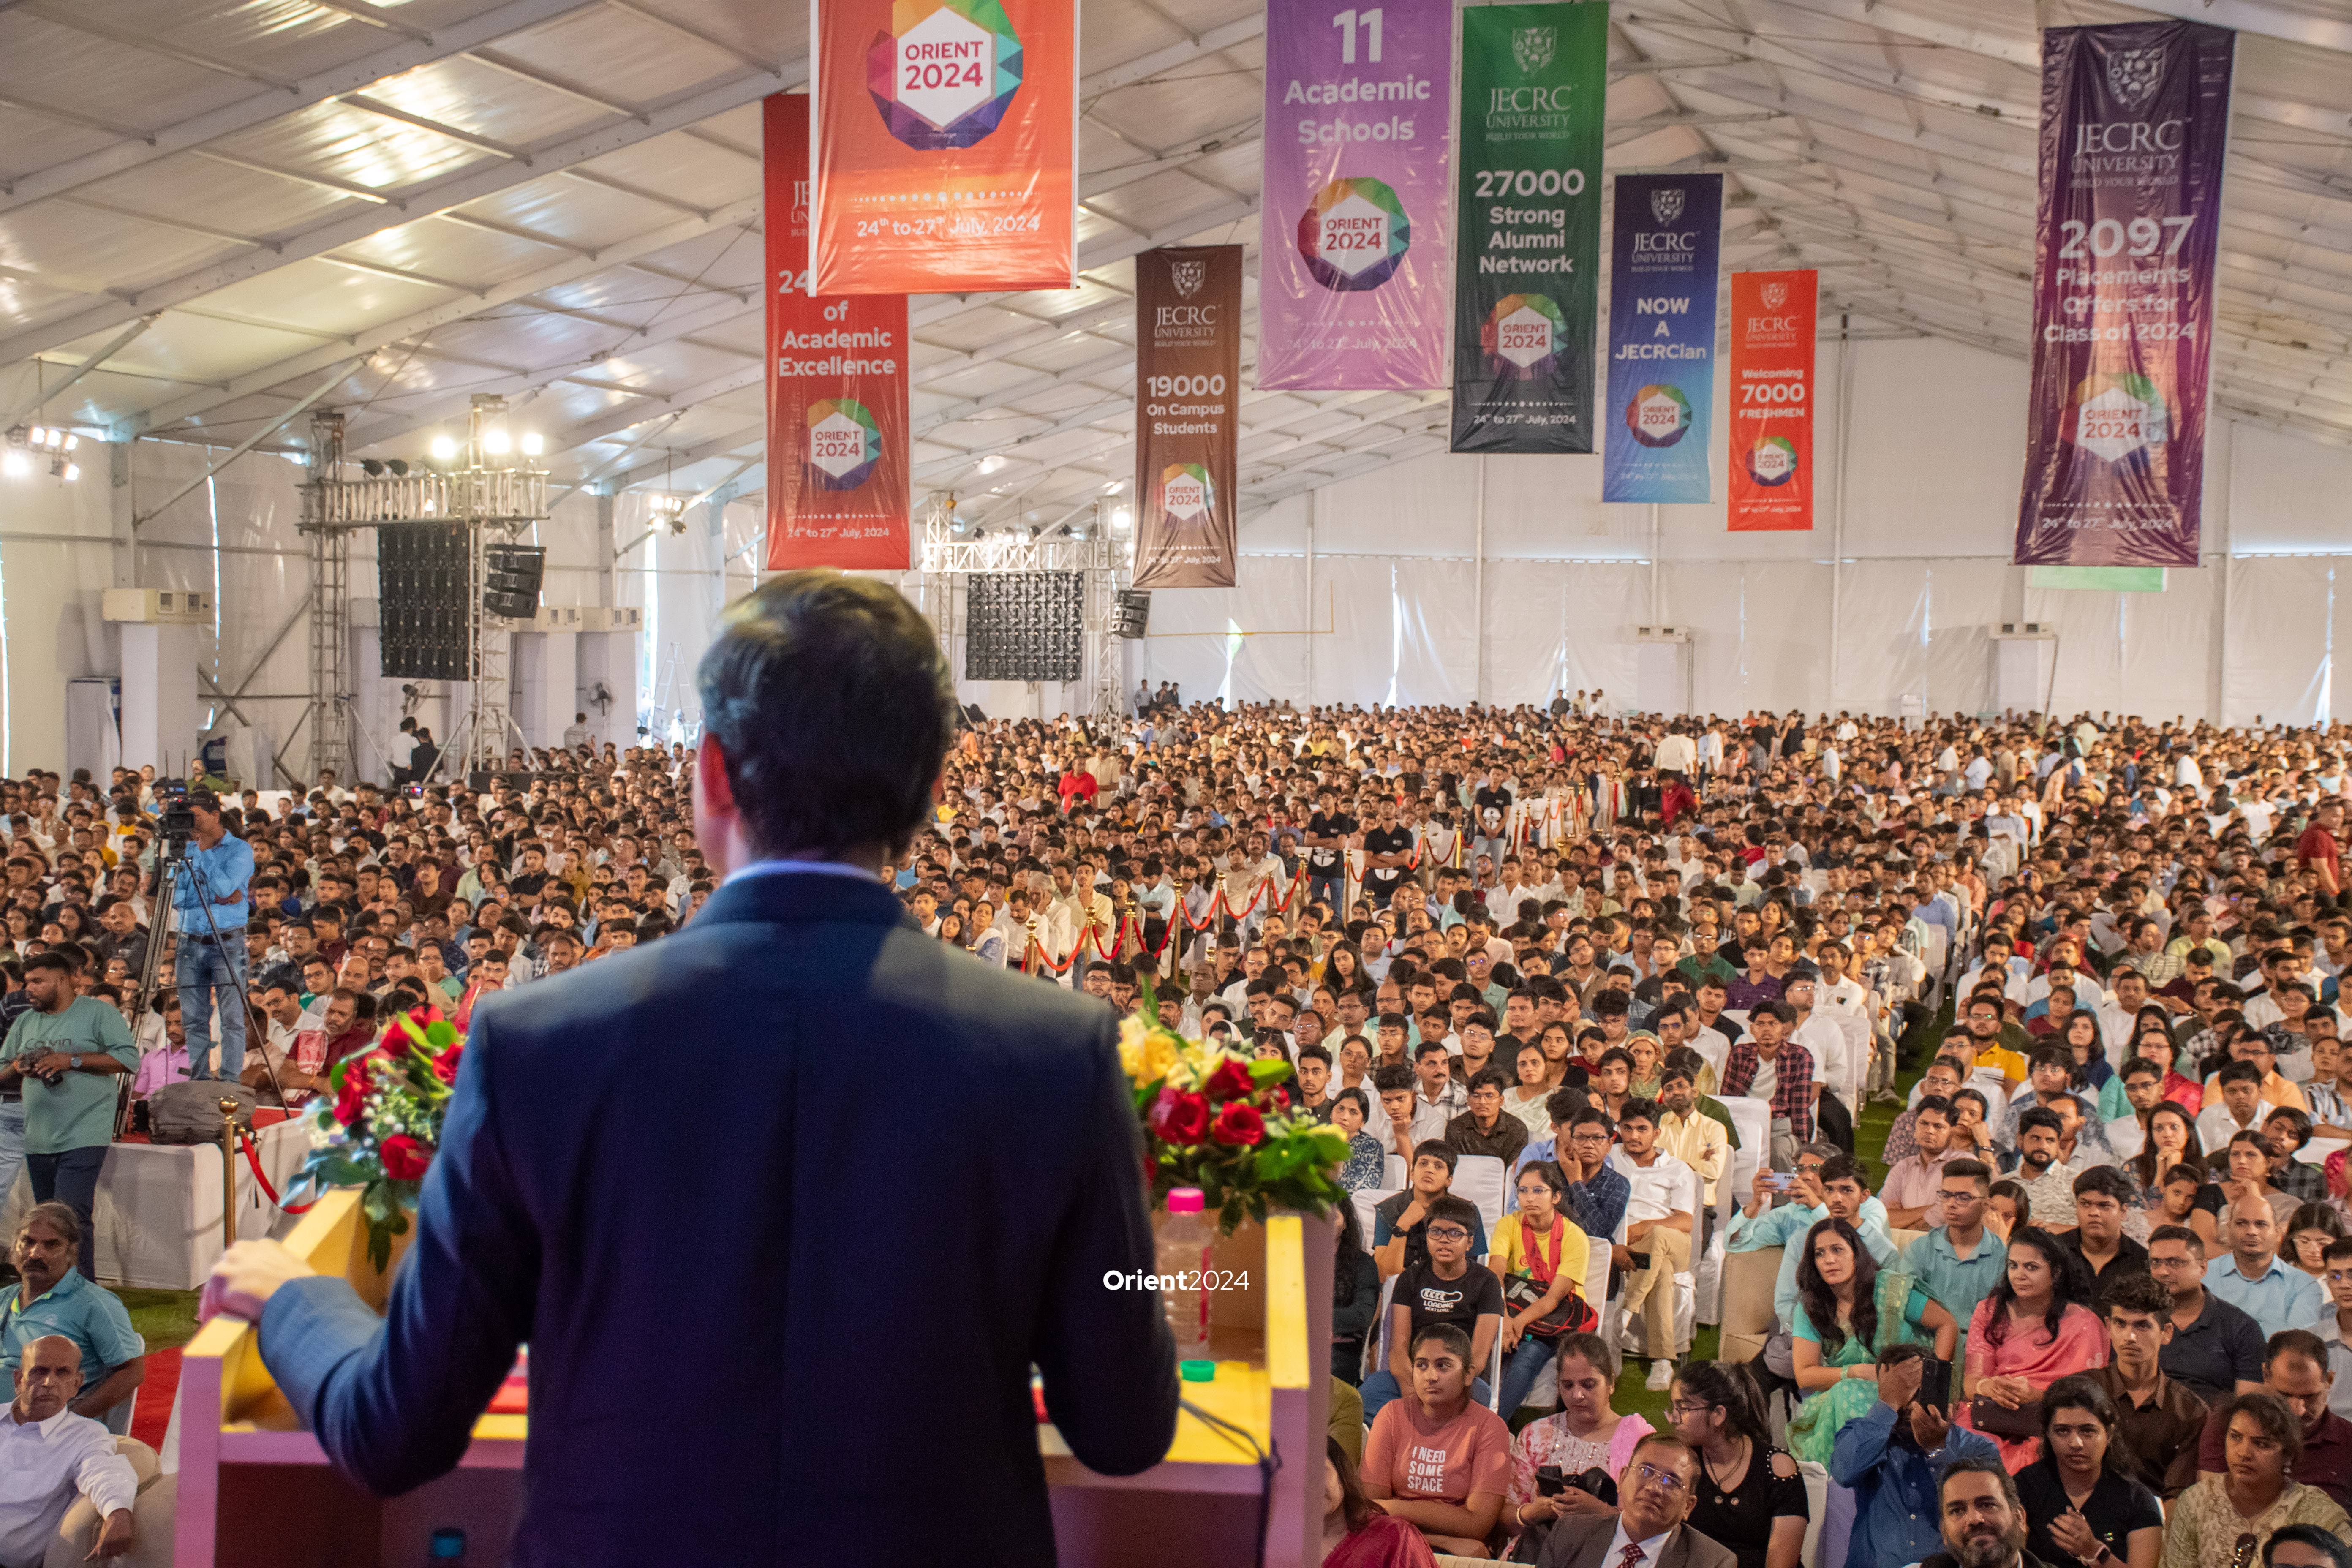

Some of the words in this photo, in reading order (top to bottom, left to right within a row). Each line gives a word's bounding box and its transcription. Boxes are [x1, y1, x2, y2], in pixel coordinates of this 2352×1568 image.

[1333, 8, 1383, 64] 11
[905, 41, 983, 60] ORIENT
[905, 62, 983, 90] 2024
[1283, 74, 1431, 105] Academic
[1489, 86, 1572, 114] JECRC
[1486, 114, 1571, 128] UNIVERSITY
[1298, 116, 1415, 144] Schools
[2074, 119, 2183, 156] JECRC
[2071, 154, 2180, 174] UNIVERSITY
[1475, 169, 1585, 197] 27000
[892, 220, 911, 235] to
[994, 216, 1040, 232] 2024
[1326, 217, 1382, 230] ORIENT
[1489, 206, 1565, 228] Strong
[1326, 232, 1382, 250] 2024
[1488, 229, 1565, 249] Alumni
[1633, 232, 1696, 252] JECRC
[2059, 216, 2196, 259] 2097
[1479, 254, 1574, 273] Network
[779, 270, 808, 293] 24
[2056, 266, 2191, 286] Placements
[824, 300, 849, 321] of
[1637, 297, 1690, 314] NOW
[2063, 295, 2138, 314] Offers
[2142, 294, 2180, 312] for
[1156, 305, 1216, 326] JECRC
[1154, 327, 1216, 338] UNIVERSITY
[1503, 324, 1547, 334] ORIENT
[1654, 320, 1670, 337] A
[1747, 316, 1797, 333] JECRC
[2044, 324, 2100, 343] Class
[2106, 323, 2132, 341] of
[2136, 322, 2196, 340] 2024
[782, 327, 892, 350] Academic
[1503, 335, 1546, 348] 2024
[1615, 343, 1707, 360] JECRCian
[779, 356, 896, 376] Excellence
[1742, 368, 1804, 379] Welcoming
[1147, 374, 1225, 397] 19000
[1740, 383, 1805, 403] 7000
[1147, 403, 1166, 416] On
[1169, 403, 1225, 417] Campus
[1739, 408, 1805, 419] FRESHMEN
[2085, 409, 2142, 420] ORIENT
[1493, 415, 1504, 424] to
[1550, 415, 1576, 425] 2024
[1642, 414, 1675, 425] 2024
[815, 430, 860, 441] ORIENT
[1154, 422, 1217, 435] Students
[2085, 422, 2140, 439] 2024
[815, 442, 860, 457] 2024
[1758, 460, 1785, 469] 2024
[1169, 495, 1200, 506] 2024
[2067, 518, 2081, 529] to
[2141, 518, 2173, 529] 2024
[806, 528, 818, 538] to
[864, 528, 890, 537] 2024
[1202, 556, 1221, 564] 2024
[25, 1038, 71, 1050] Cavin
[1423, 1300, 1454, 1309] LOADING
[1412, 1446, 1418, 1458] I
[1418, 1446, 1446, 1463] NEED
[1409, 1460, 1444, 1477] SOME
[1407, 1475, 1443, 1492] SPACE
